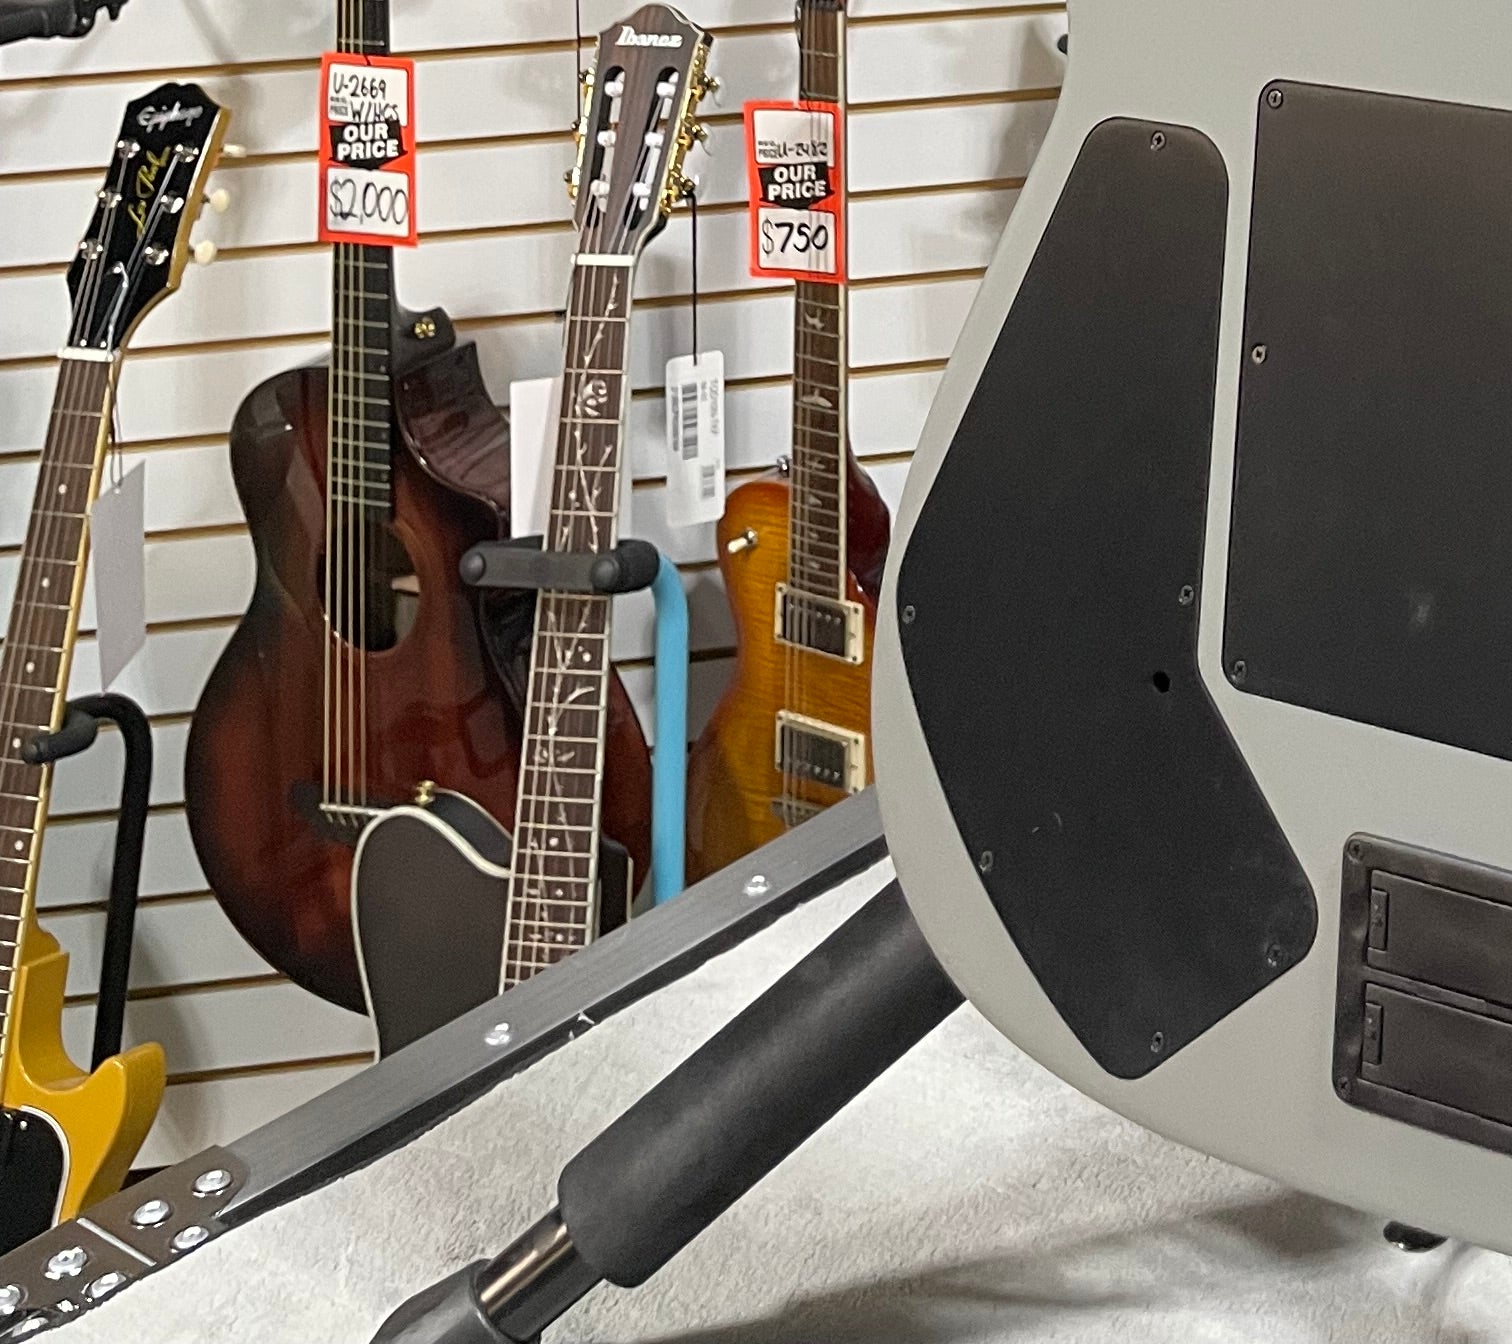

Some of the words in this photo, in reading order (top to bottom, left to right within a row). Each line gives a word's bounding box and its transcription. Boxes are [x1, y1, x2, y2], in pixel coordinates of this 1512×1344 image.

[614, 25, 683, 48] Ibanez
[343, 123, 389, 143] OUR
[336, 138, 400, 162] PRICE
[773, 164, 817, 184] OUR
[329, 178, 408, 225] $2,000
[767, 180, 827, 202] PRICE
[761, 217, 829, 258] $750
